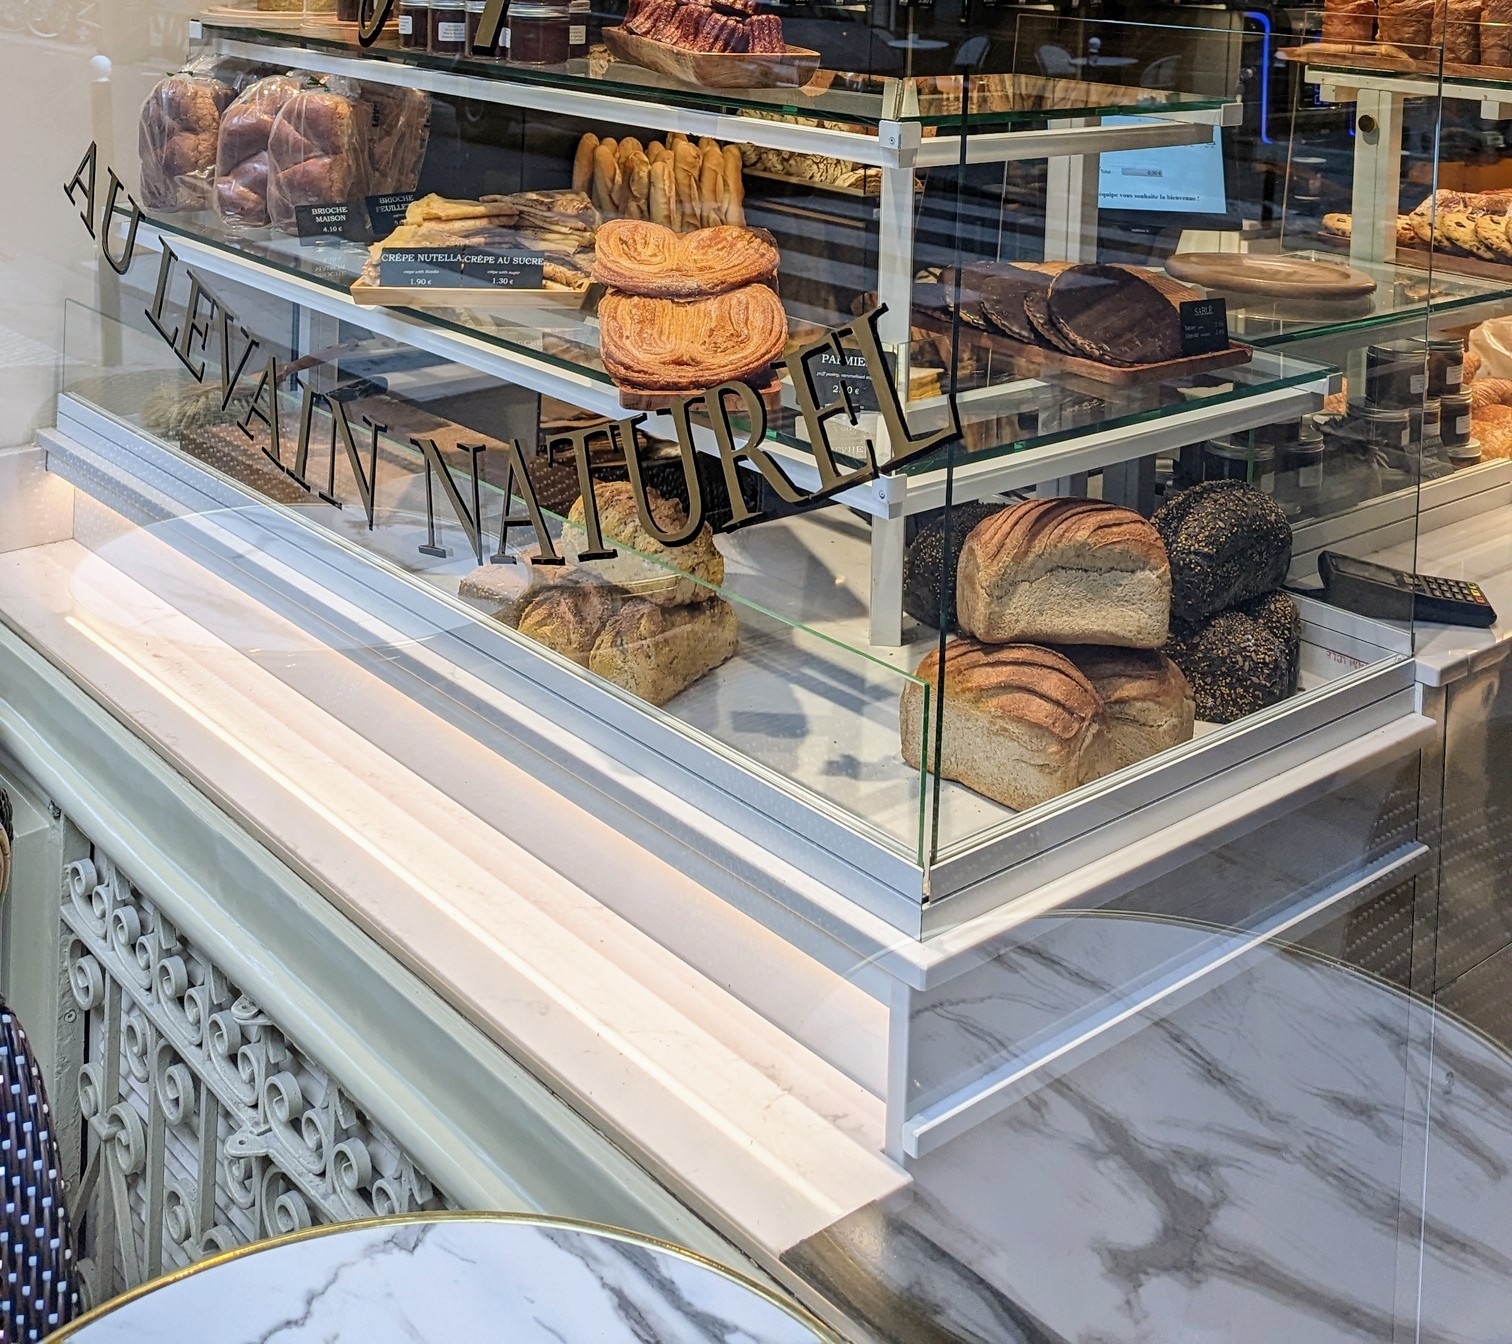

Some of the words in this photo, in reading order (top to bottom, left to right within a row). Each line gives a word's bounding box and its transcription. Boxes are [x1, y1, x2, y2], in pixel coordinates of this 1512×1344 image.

[380, 195, 414, 204] BRIOCHE
[312, 206, 348, 215] BRIOCHE
[316, 215, 346, 223] MAISON
[381, 252, 415, 262] CRÊPE
[417, 253, 462, 262] NUTELLA
[464, 254, 496, 264] CRÊPE
[62, 140, 147, 276] AU
[144, 235, 388, 533] LEVAIN
[408, 302, 963, 566] NATUREL
[821, 354, 868, 366] PAMIE
[832, 385, 853, 394] 2.0
